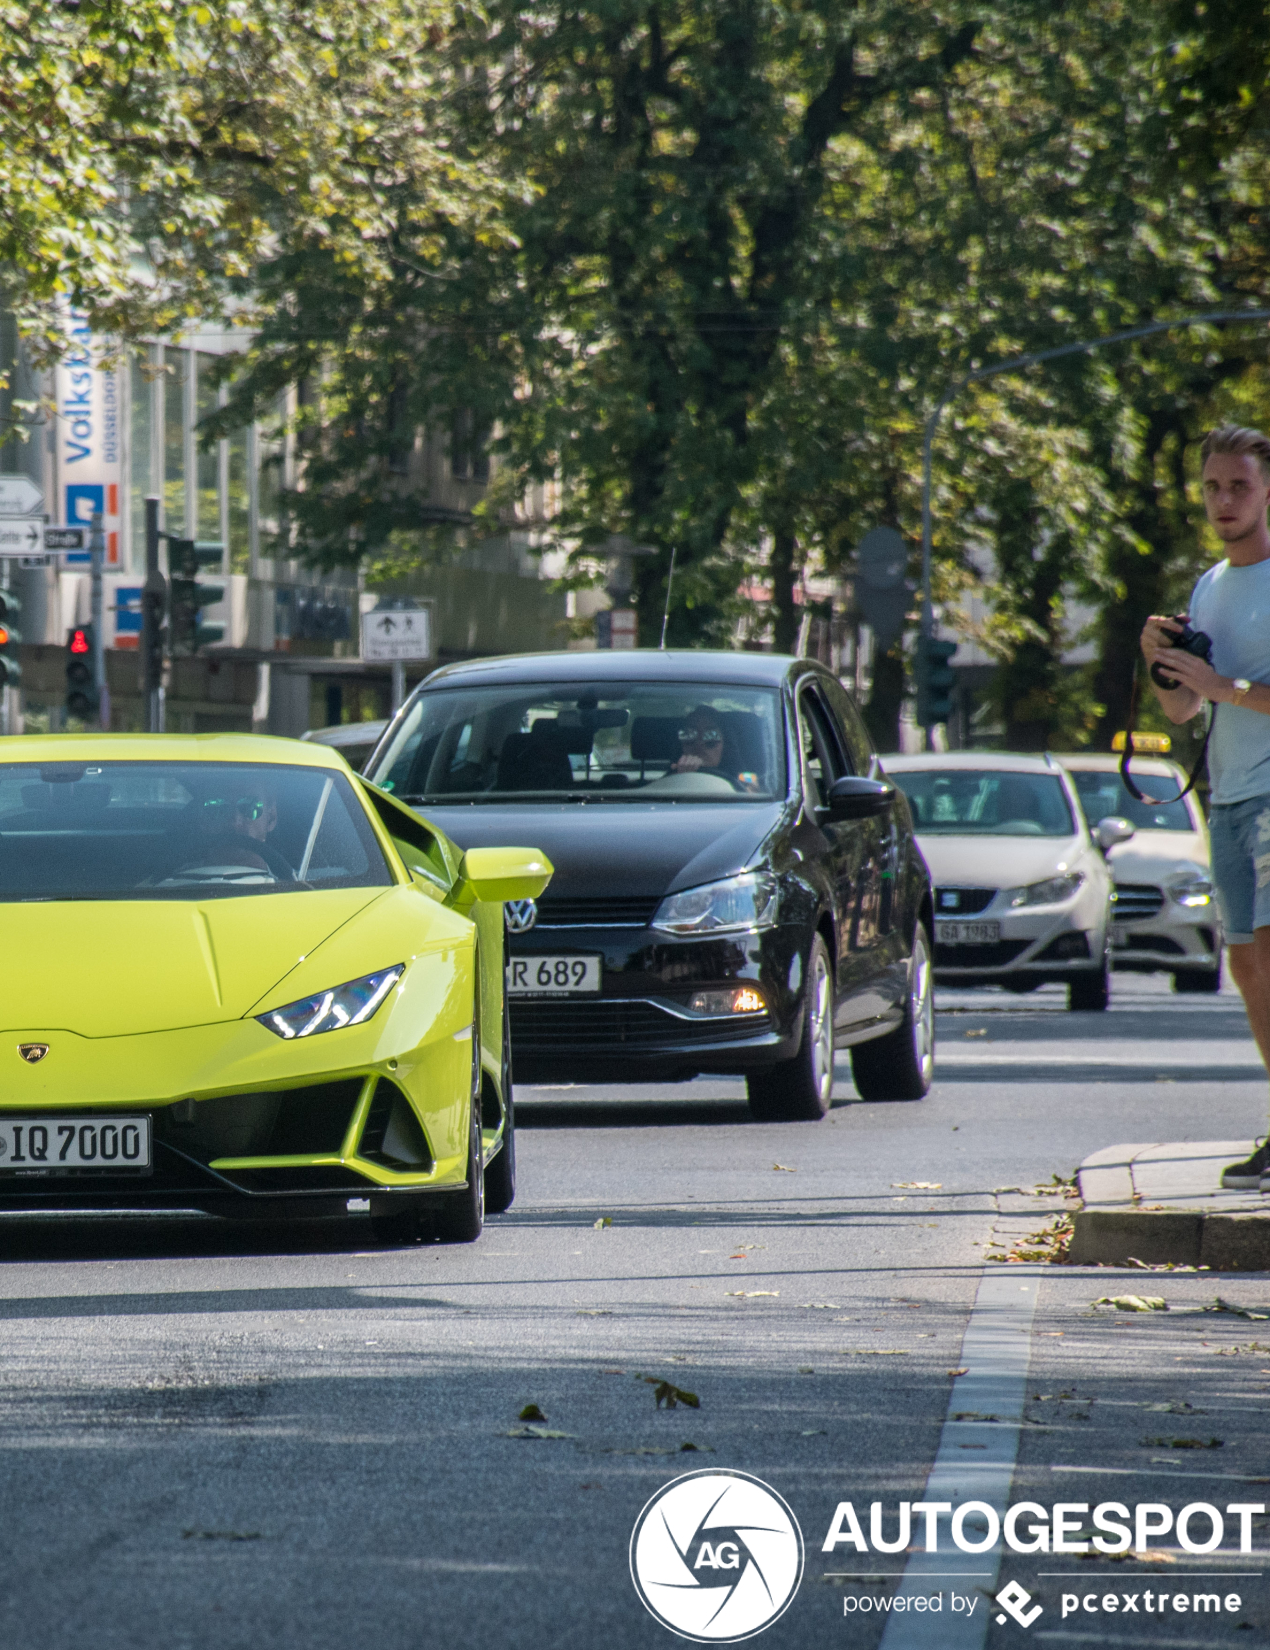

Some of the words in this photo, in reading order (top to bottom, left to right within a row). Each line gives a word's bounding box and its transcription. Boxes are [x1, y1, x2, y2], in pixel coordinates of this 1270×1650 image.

[536, 960, 587, 987] 689
[10, 1125, 49, 1163] IQ
[57, 1124, 140, 1161] 7000
